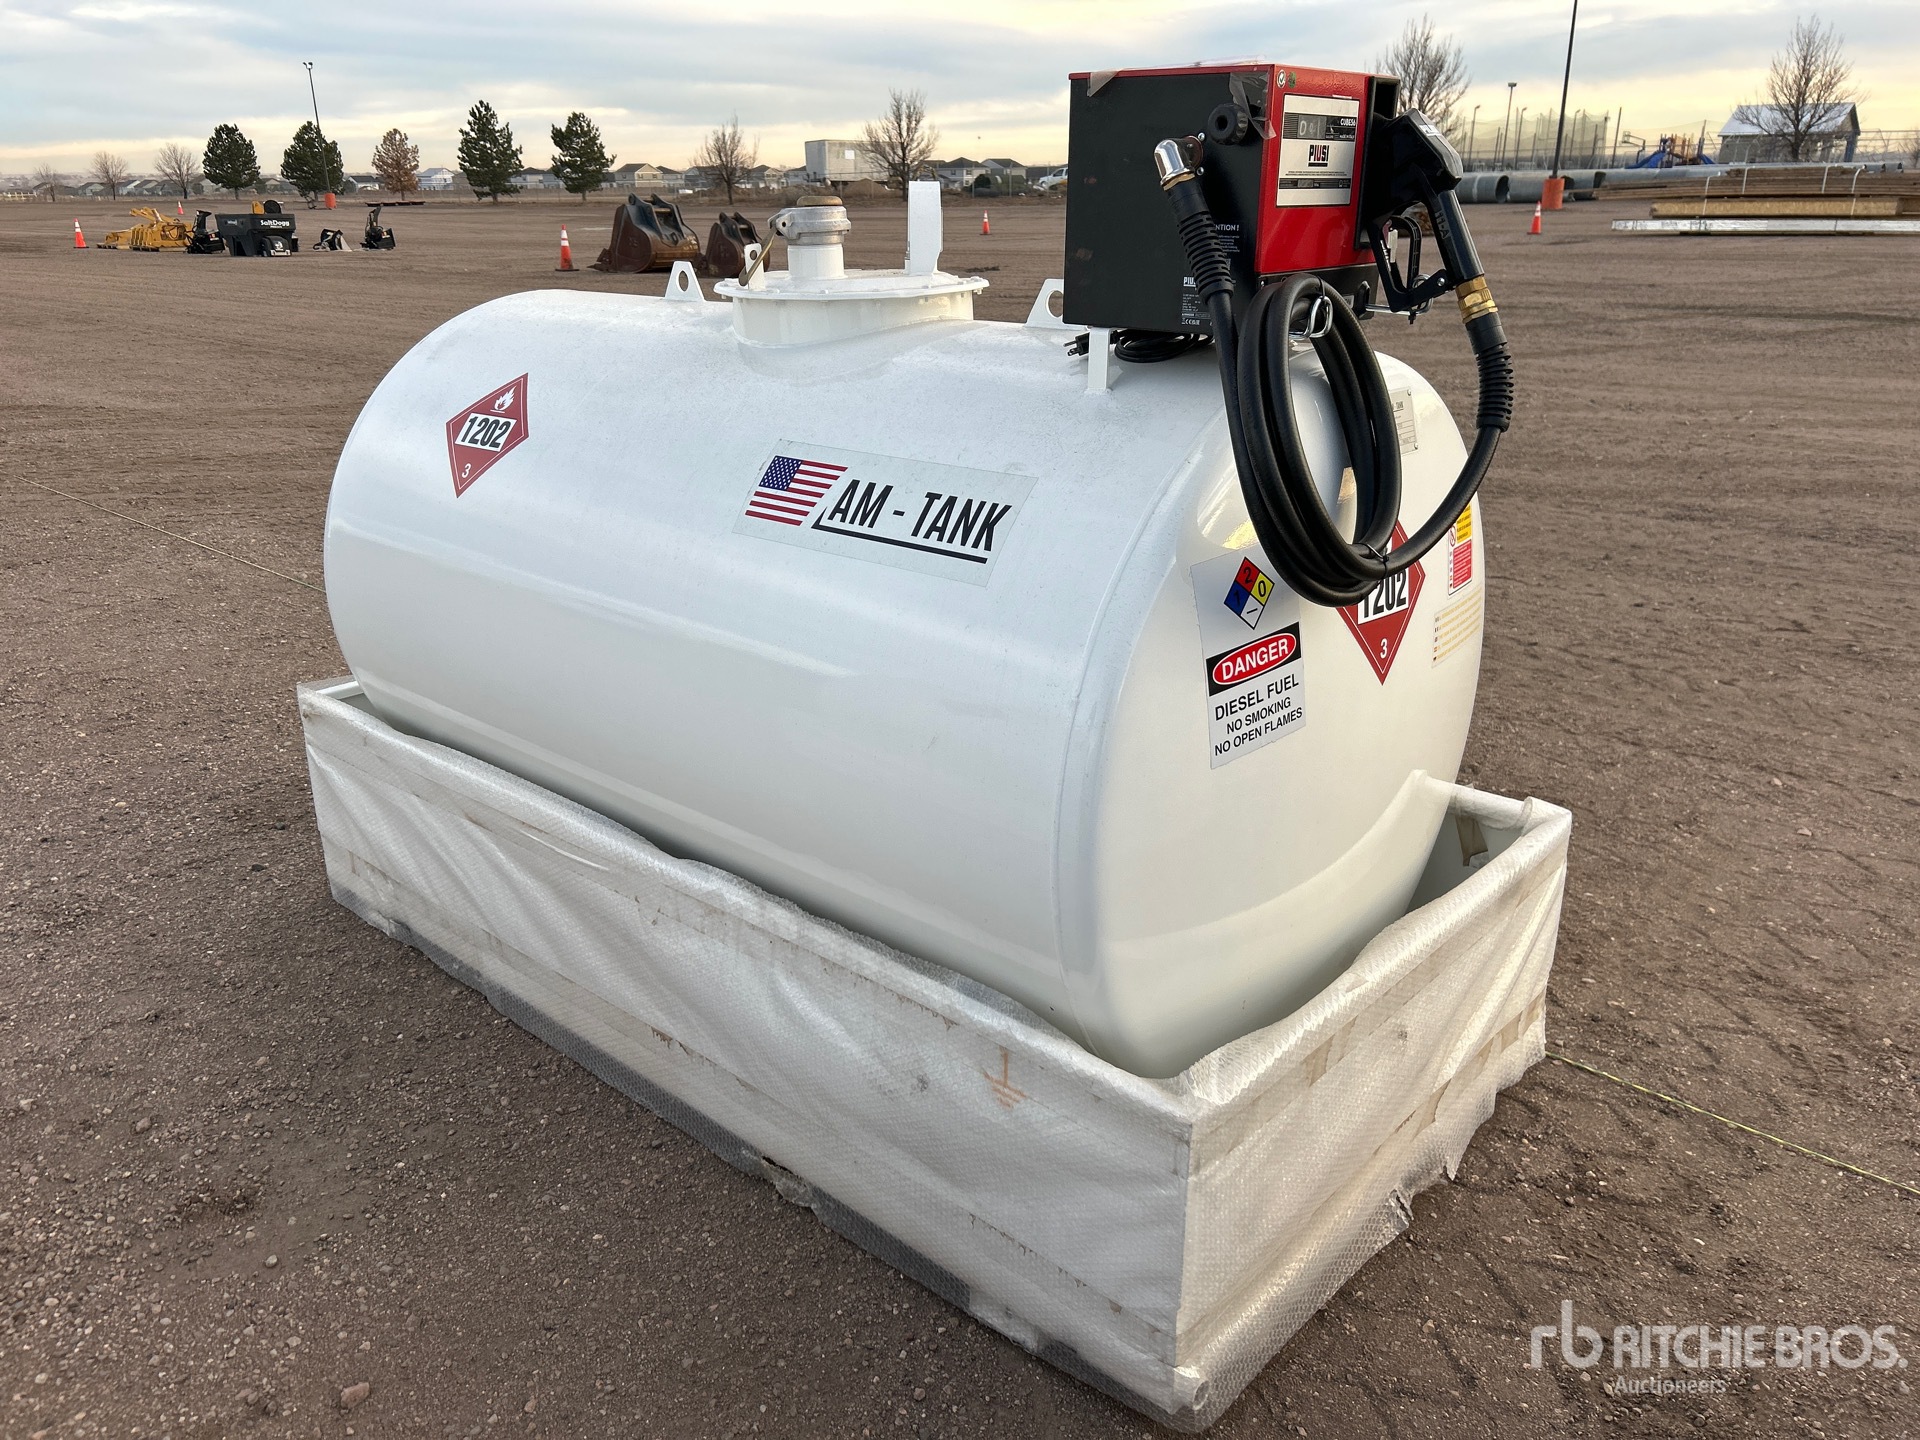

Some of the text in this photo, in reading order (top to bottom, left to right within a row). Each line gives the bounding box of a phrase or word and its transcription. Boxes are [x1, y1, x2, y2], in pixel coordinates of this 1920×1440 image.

[1308, 144, 1330, 162] PIUSI
[260, 219, 290, 227] SaltDogg
[1183, 276, 1196, 285] PIU
[460, 416, 512, 449] 1202
[461, 463, 472, 479] 3
[827, 478, 894, 529] AM
[910, 491, 1013, 552] TANK
[1242, 566, 1253, 584] 2
[1233, 589, 1241, 605] 1
[1257, 579, 1267, 598] 0
[1363, 569, 1407, 619] 1202
[1380, 638, 1388, 659] 3
[1221, 638, 1290, 681] DANGER
[1214, 673, 1299, 721] DIESEL FUEL
[1226, 696, 1292, 735] NO SMOKING
[1214, 706, 1303, 756] NO OPEN FLAMES
